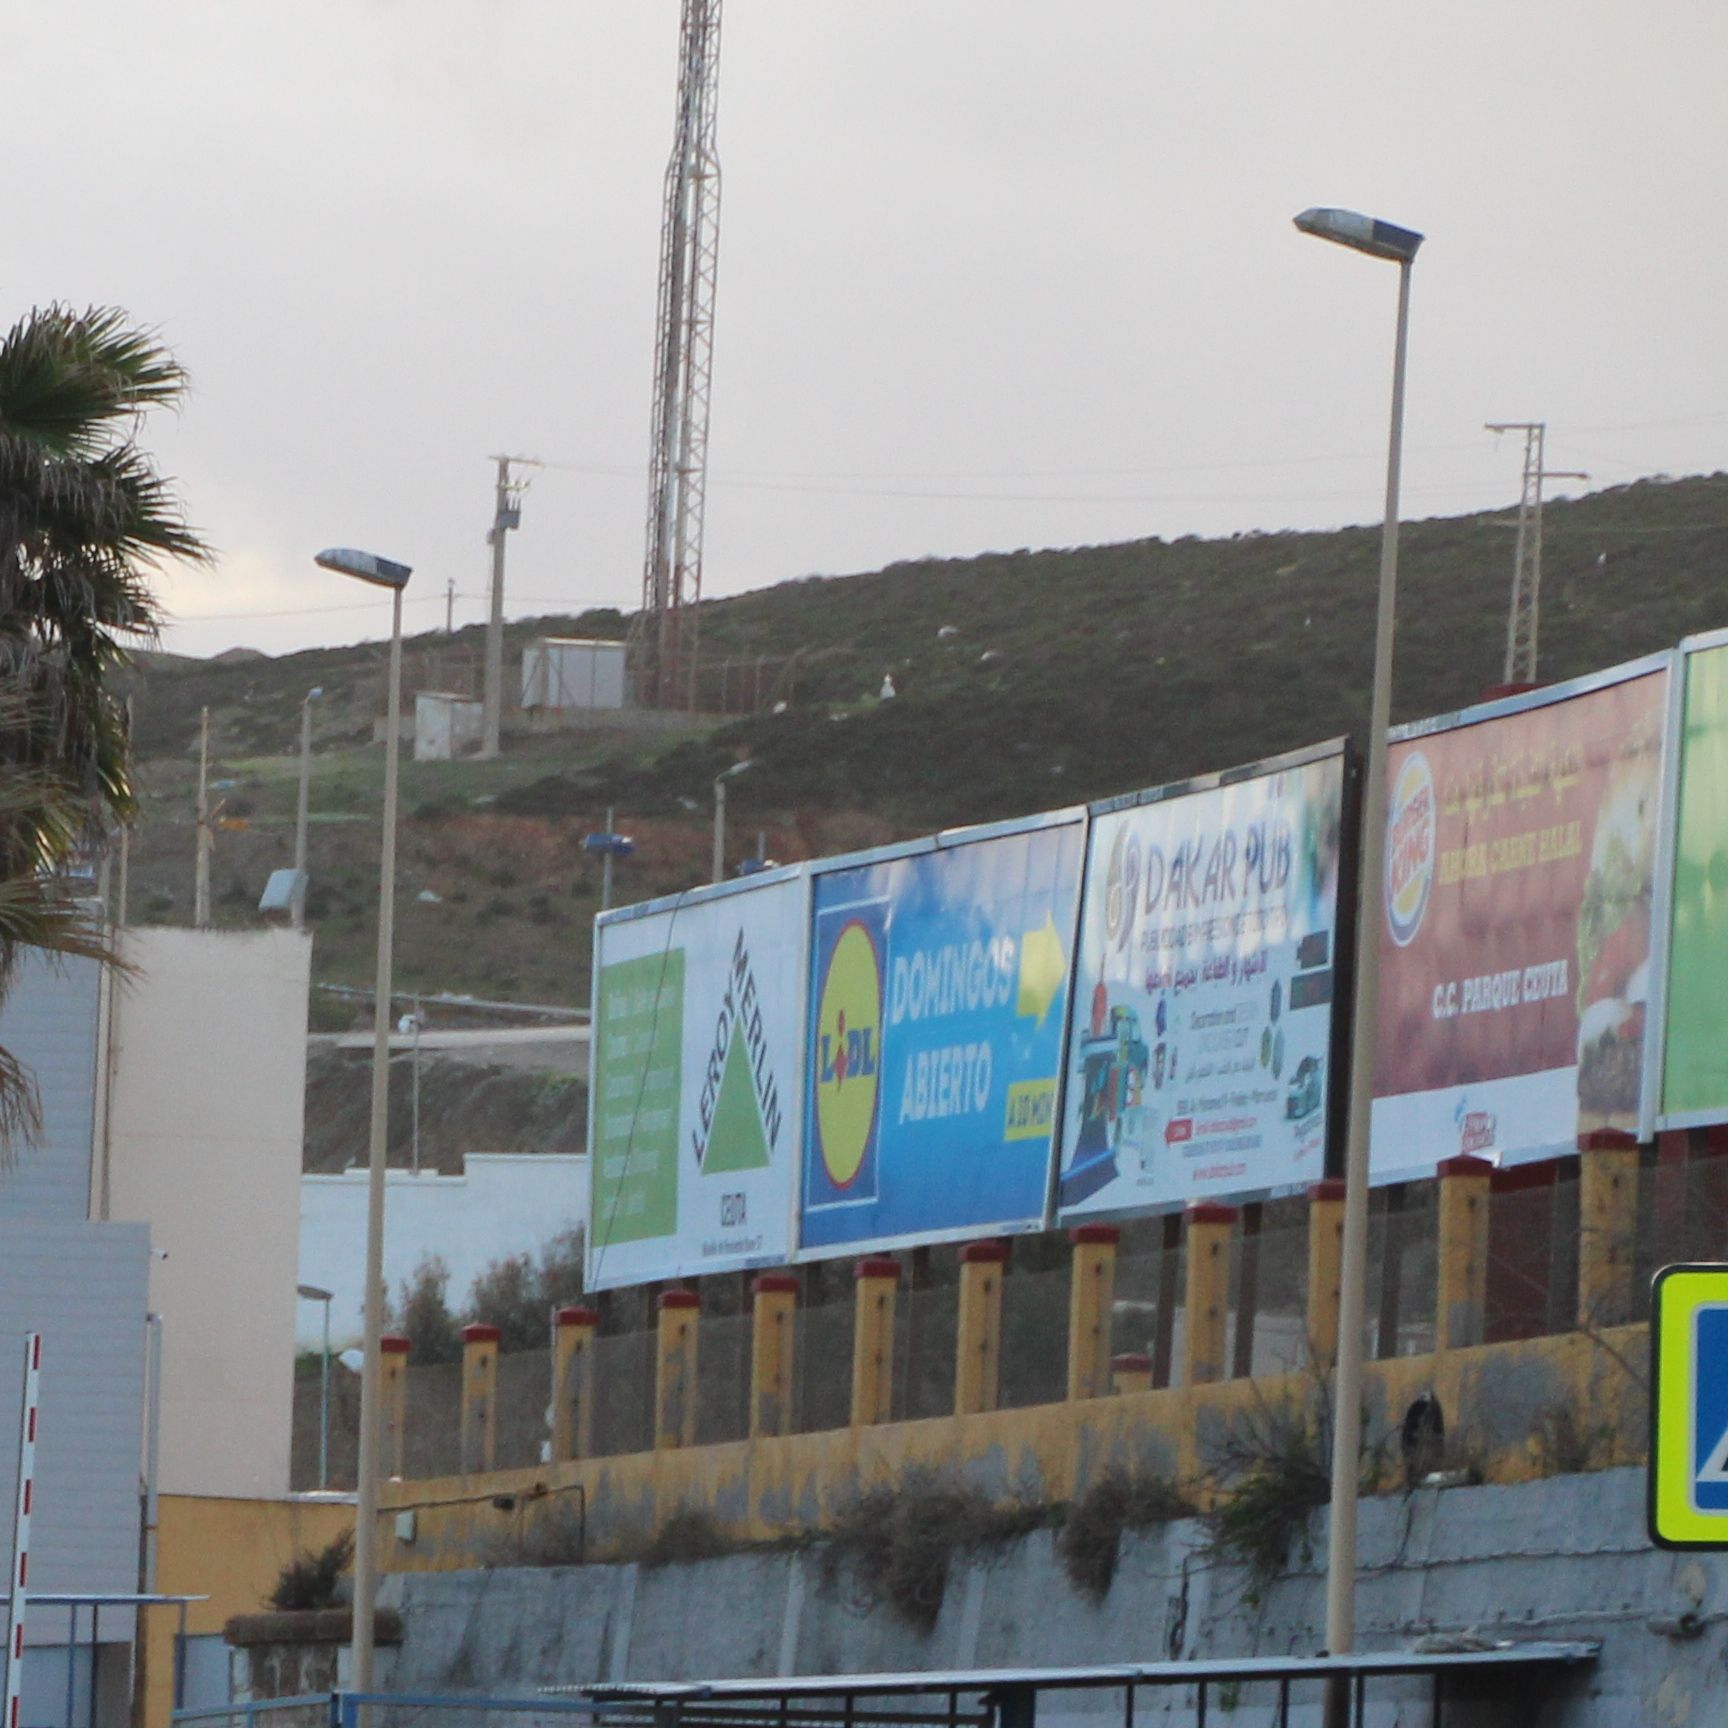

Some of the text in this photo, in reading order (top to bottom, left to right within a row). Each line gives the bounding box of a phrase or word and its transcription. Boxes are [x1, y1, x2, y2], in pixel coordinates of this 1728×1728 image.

[1144, 819, 1291, 916] DAKAR PUB
[891, 936, 1014, 1026] DOMINGOS
[692, 970, 735, 1167] LEROY
[734, 924, 782, 1150] MERLIN
[898, 1040, 991, 1125] ABIERTO
